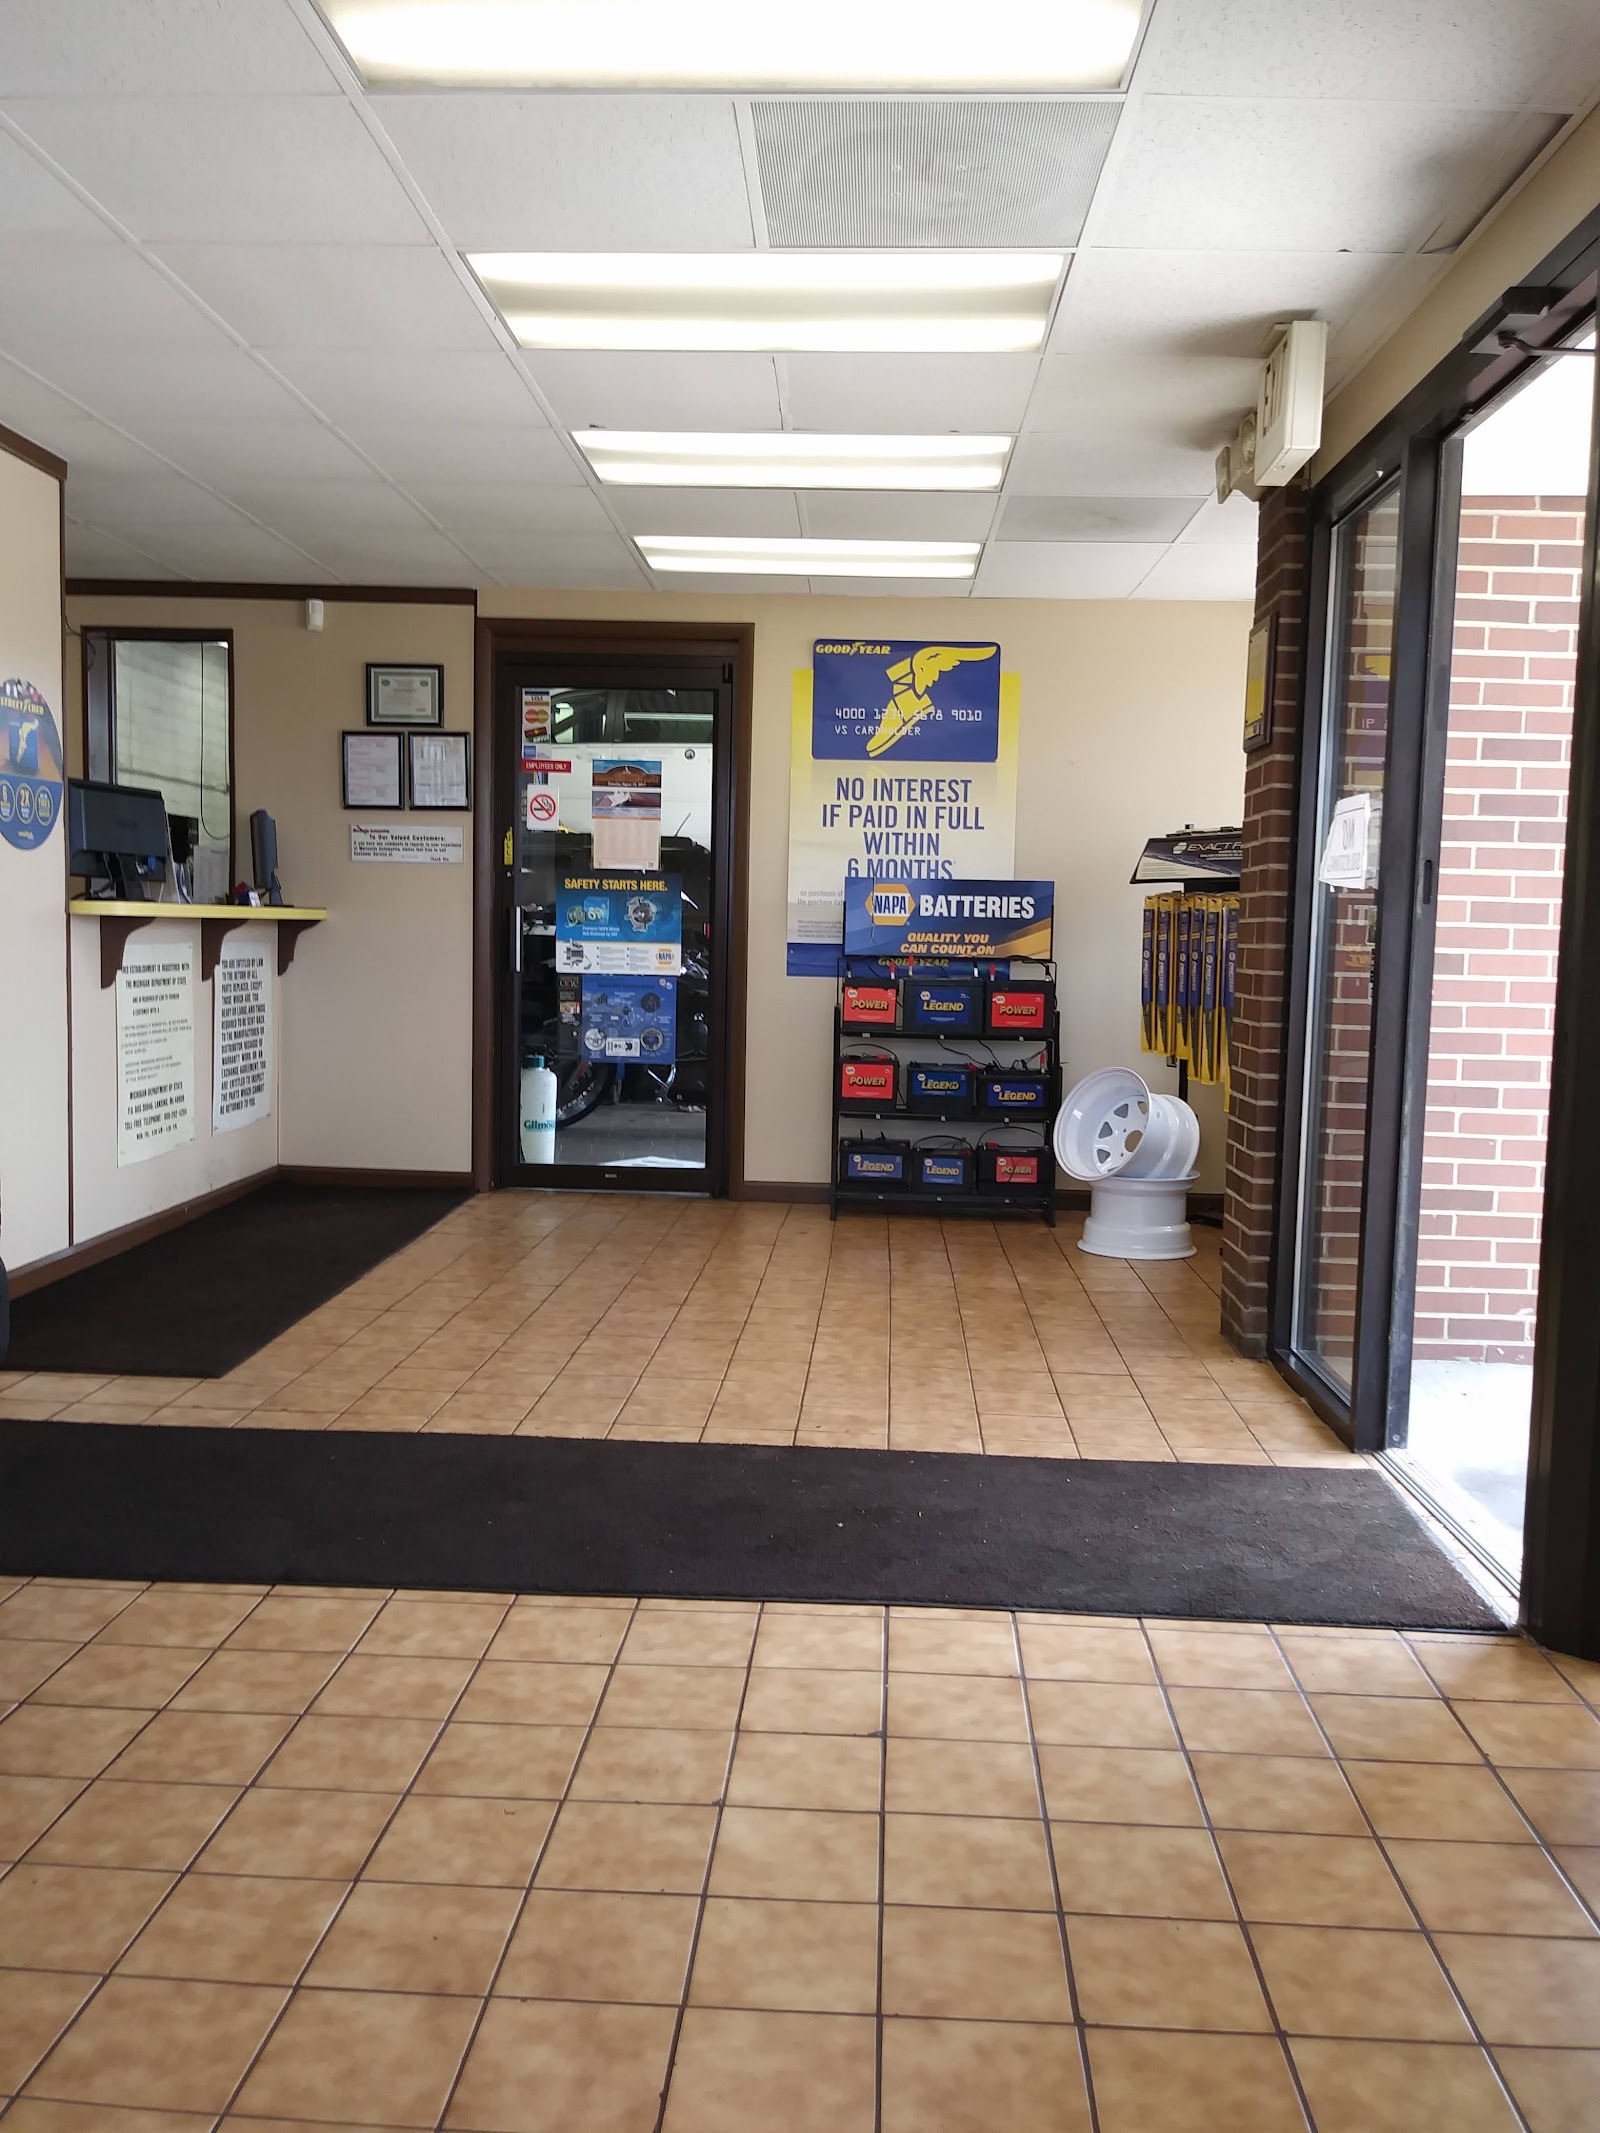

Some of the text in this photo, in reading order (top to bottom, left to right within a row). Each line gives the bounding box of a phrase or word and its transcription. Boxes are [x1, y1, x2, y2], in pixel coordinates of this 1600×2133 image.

[815, 642, 892, 656] GOODYEAR
[835, 708, 982, 722] 4000 1234 5678 9010
[834, 725, 921, 736] VS CARDHOLDER
[525, 762, 567, 770] EMPLOYEES ONLY
[836, 777, 973, 803] NO INTEREST
[822, 803, 985, 831] IF PAID IN FULL
[863, 831, 940, 856] WITHIN
[848, 858, 953, 880] 6 MONTHS
[564, 878, 668, 891] SAFETY STARTS HERE.
[874, 895, 1036, 920] NAPA BATTERIES
[907, 932, 990, 944] QUALITY YOU
[900, 944, 996, 955] CAN COUNT ON
[658, 952, 672, 961] NAPA
[851, 1000, 888, 1011] POWER
[923, 1001, 964, 1011] LEGEND
[999, 1006, 1037, 1016] POWER
[849, 1077, 887, 1087] POWER
[921, 1081, 959, 1090] LEGEND
[998, 1092, 1037, 1101] LEGEND
[857, 1162, 894, 1172] LEGEND
[926, 1167, 960, 1175] LEGEND
[1001, 1166, 1032, 1175] POWER
